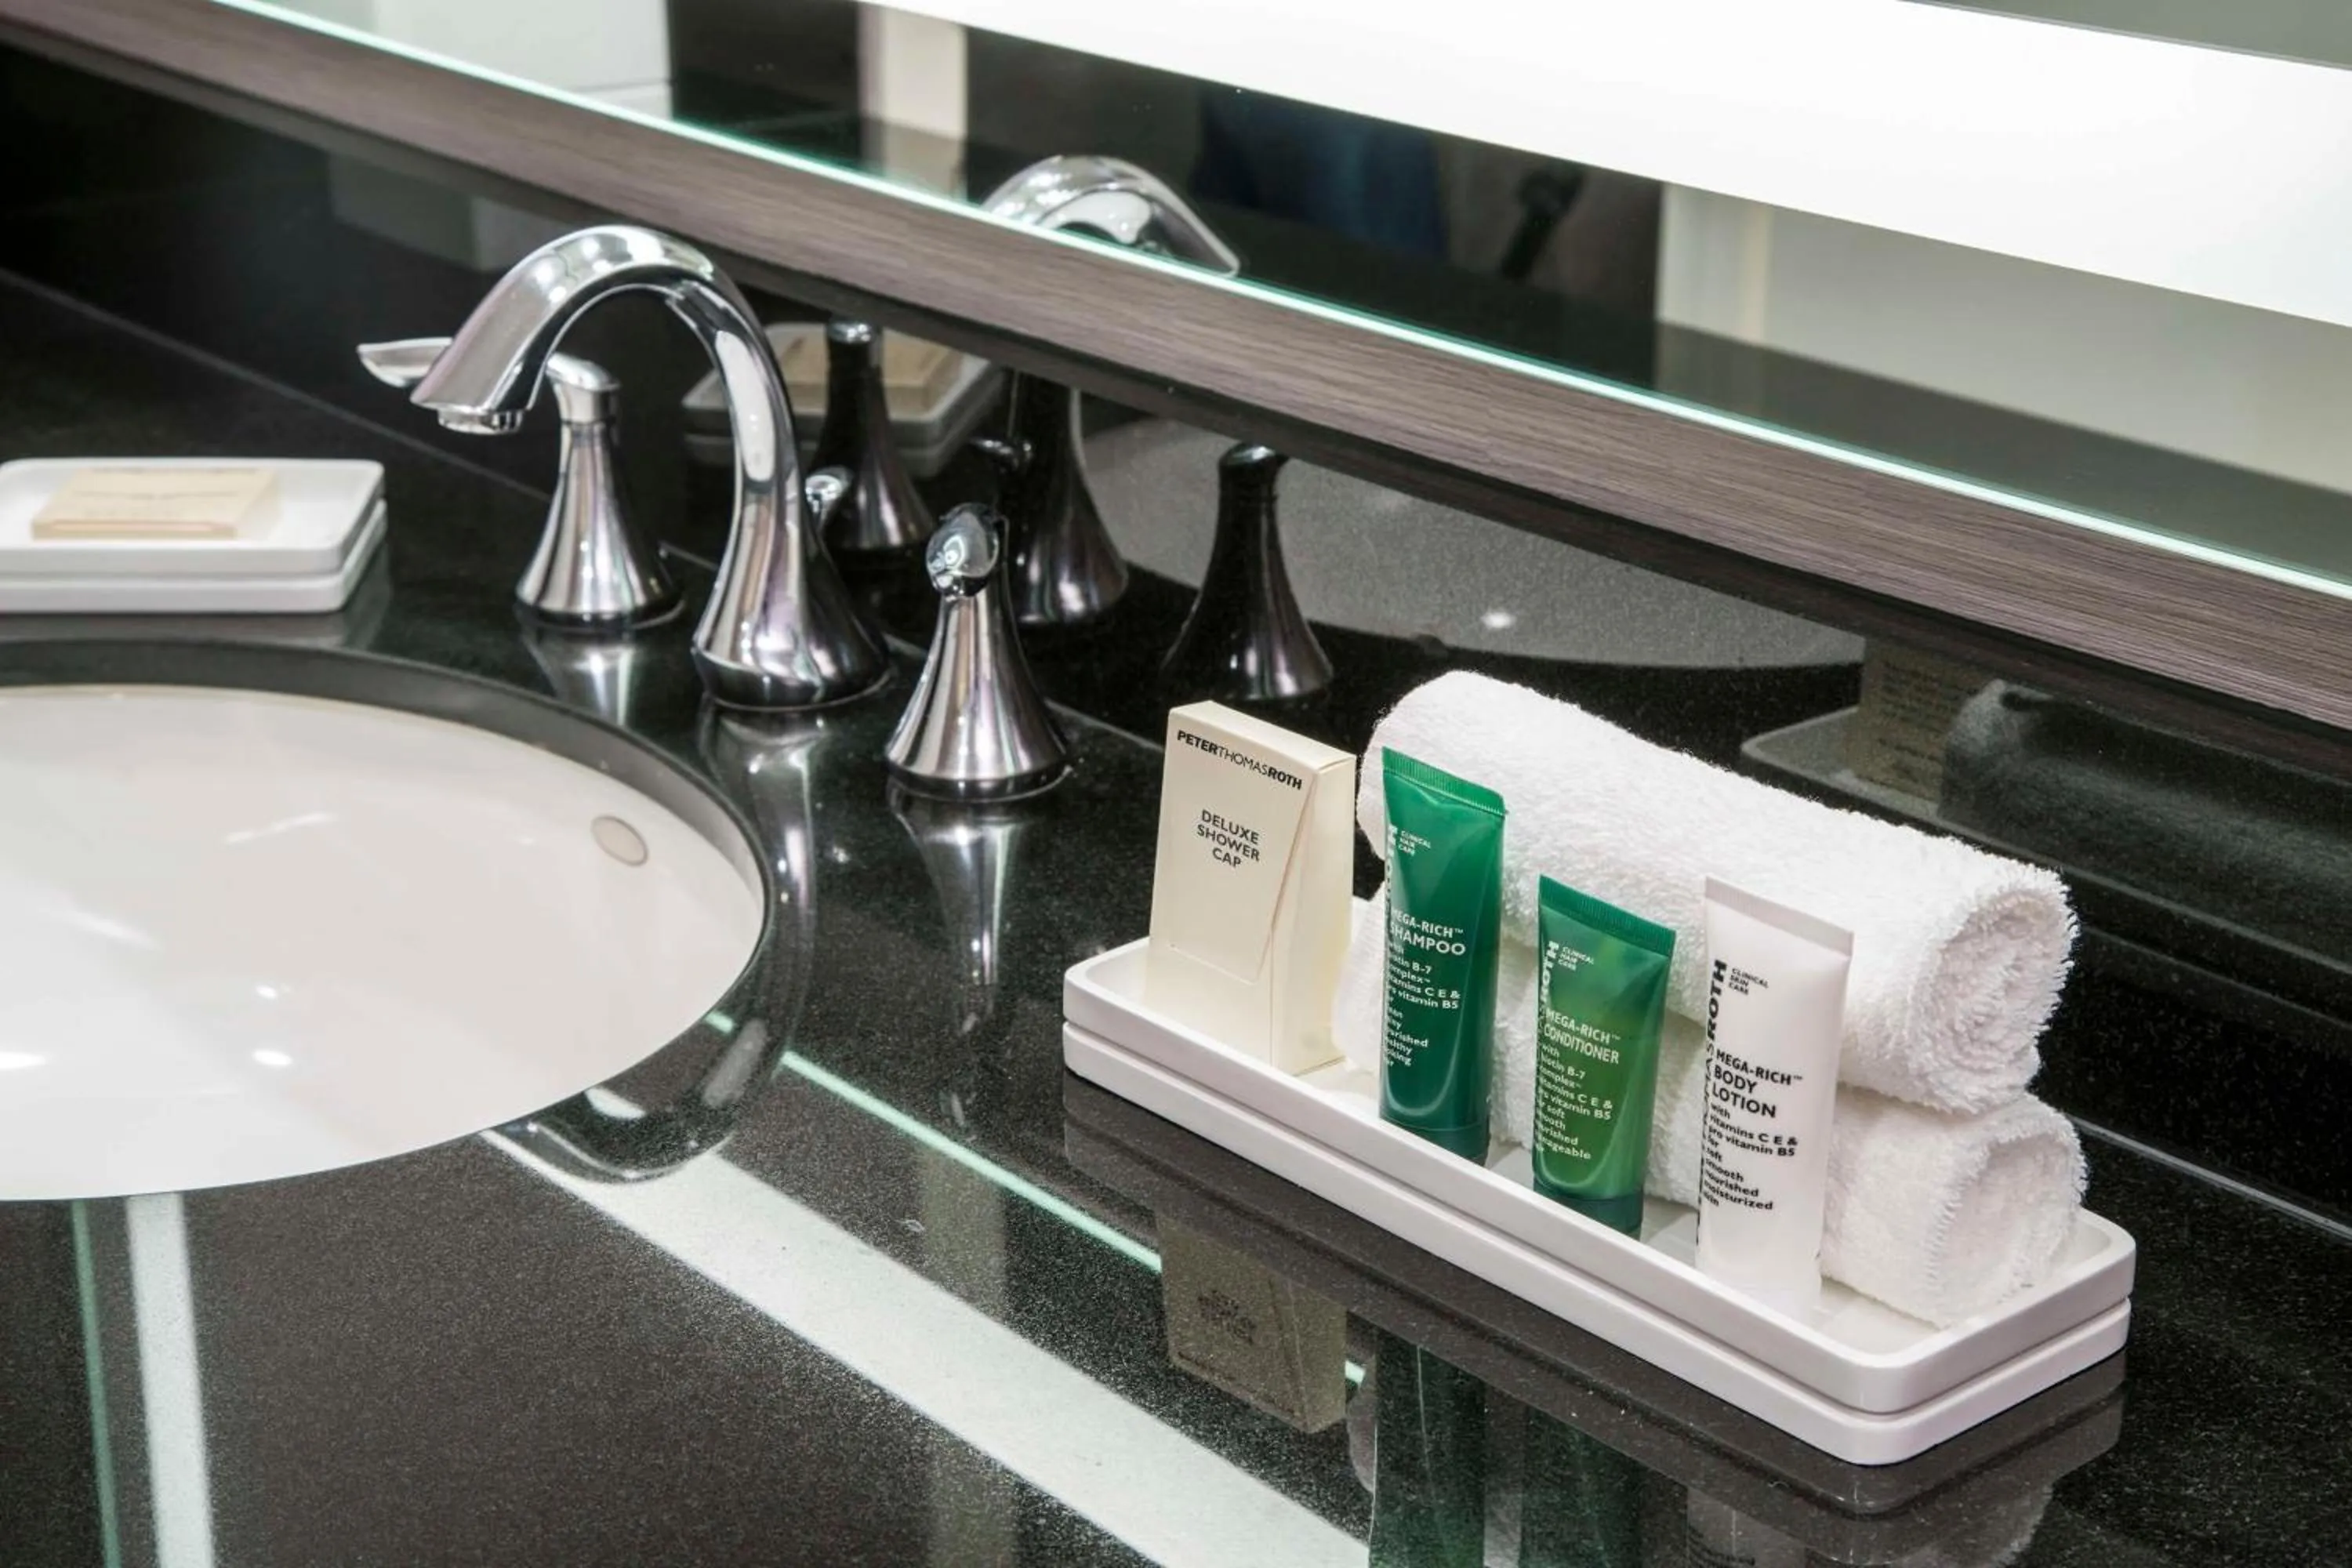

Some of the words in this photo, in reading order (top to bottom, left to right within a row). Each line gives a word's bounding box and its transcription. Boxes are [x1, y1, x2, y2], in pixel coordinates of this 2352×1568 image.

[1202, 810, 1259, 845] DELUXE
[1196, 824, 1260, 862] SHOWER
[1212, 848, 1241, 869] CAP
[1425, 987, 1436, 996] C
[1438, 988, 1447, 998] E
[1544, 1023, 1619, 1065] CONDITIONER
[1714, 1064, 1758, 1094] BODY
[1577, 1094, 1588, 1104] C
[1711, 1081, 1776, 1119] LOTION
[1710, 1102, 1731, 1120] with
[1726, 1135, 1773, 1156] vitamin
[1777, 1147, 1795, 1157] B5
[1757, 1133, 1769, 1143] C
[1773, 1134, 1784, 1145] E
